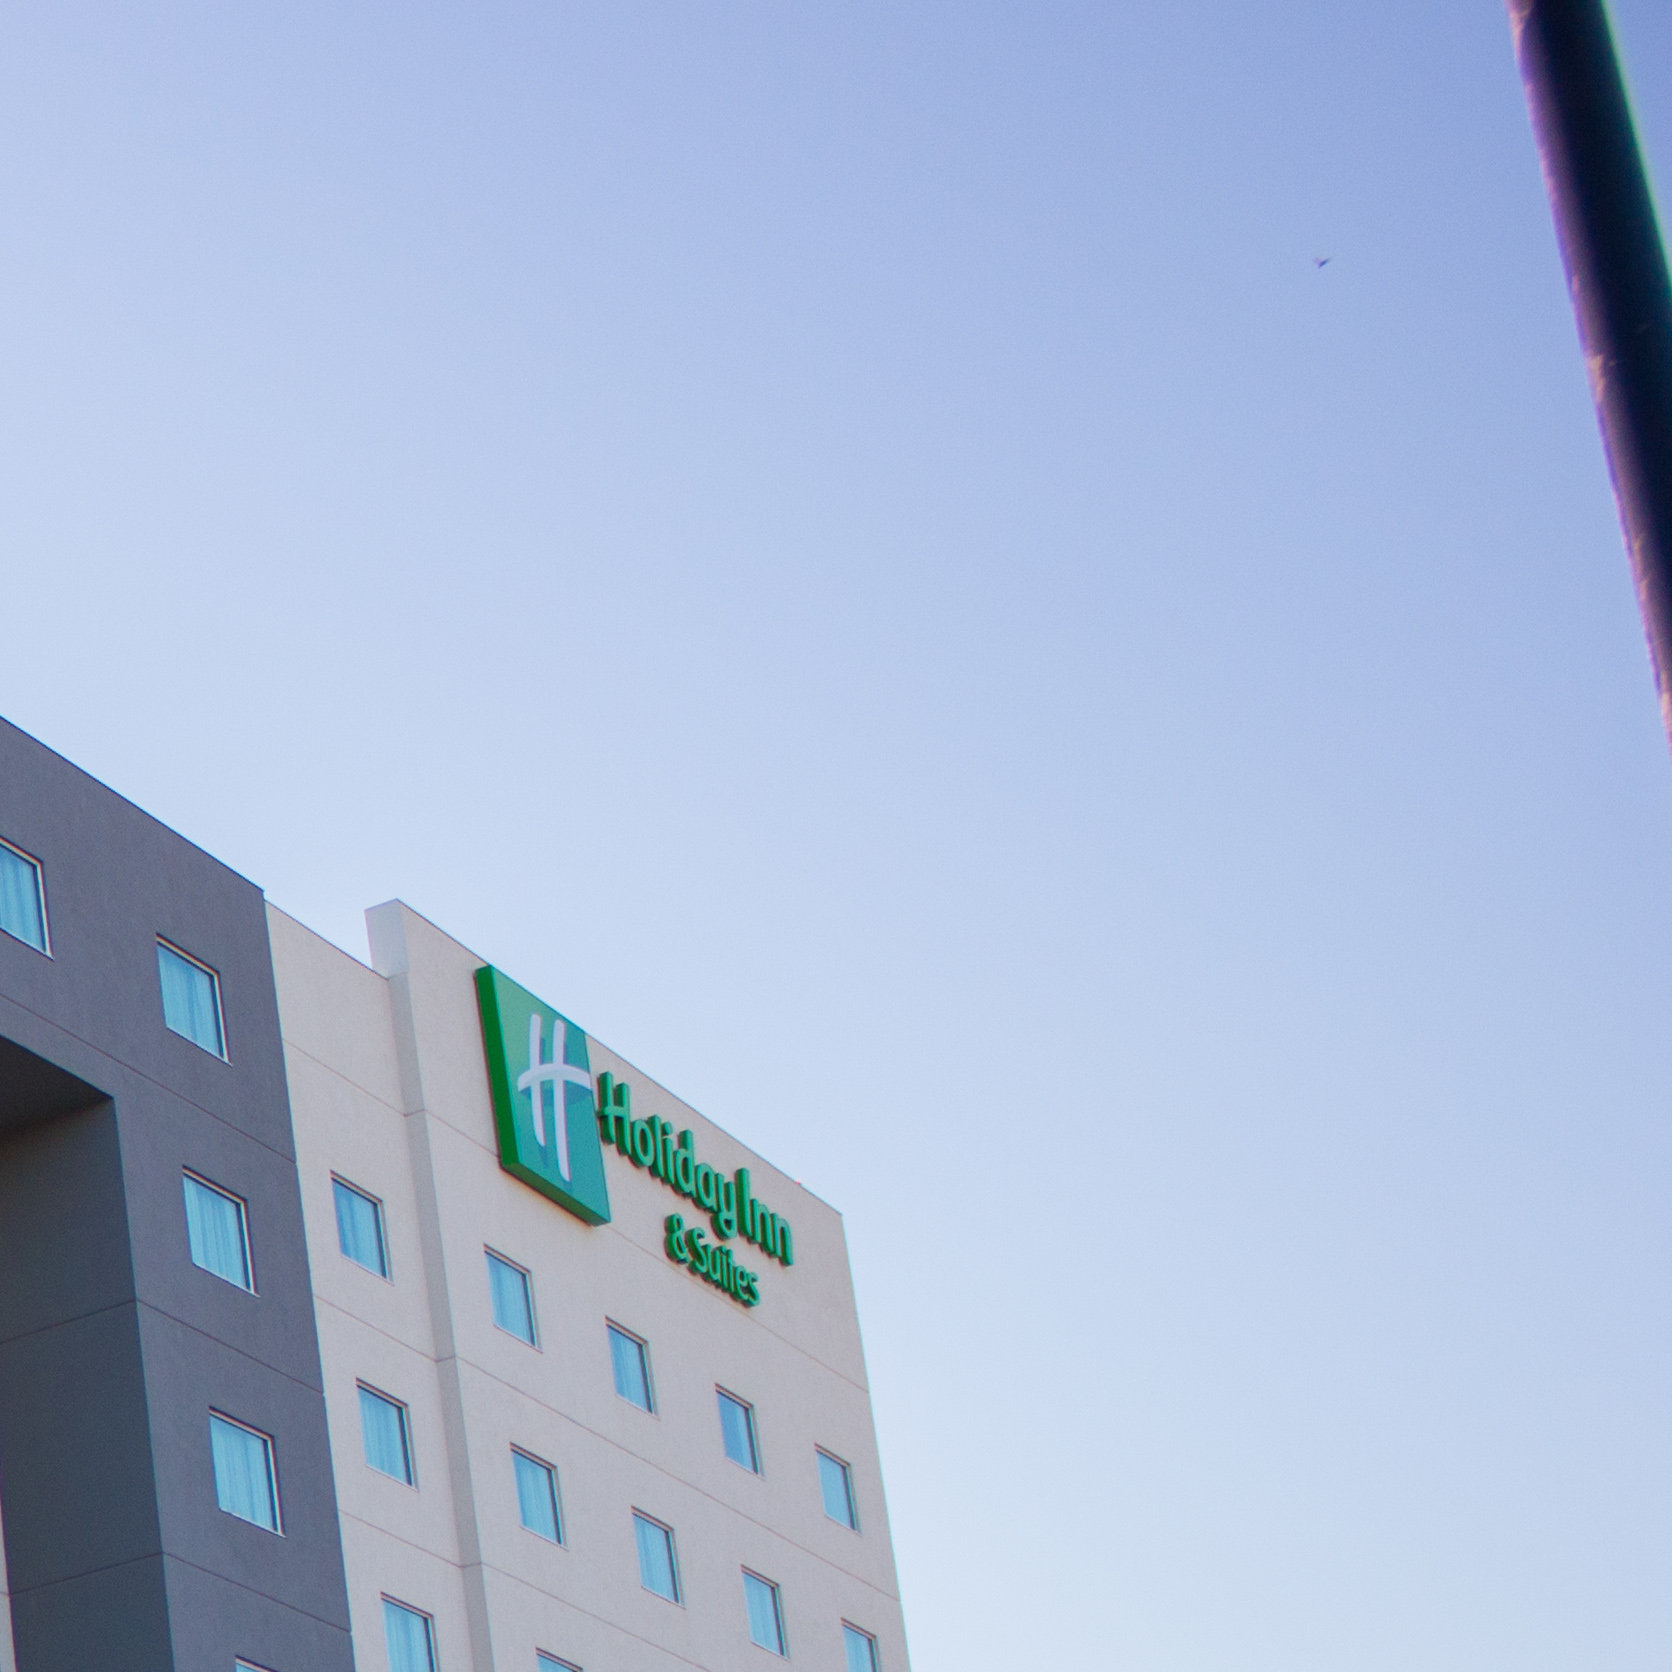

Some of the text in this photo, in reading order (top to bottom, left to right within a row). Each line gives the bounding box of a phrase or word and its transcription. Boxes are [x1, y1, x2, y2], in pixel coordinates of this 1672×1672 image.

[597, 1071, 794, 1267] Holiday Inn
[665, 1213, 761, 1308] & Suites
